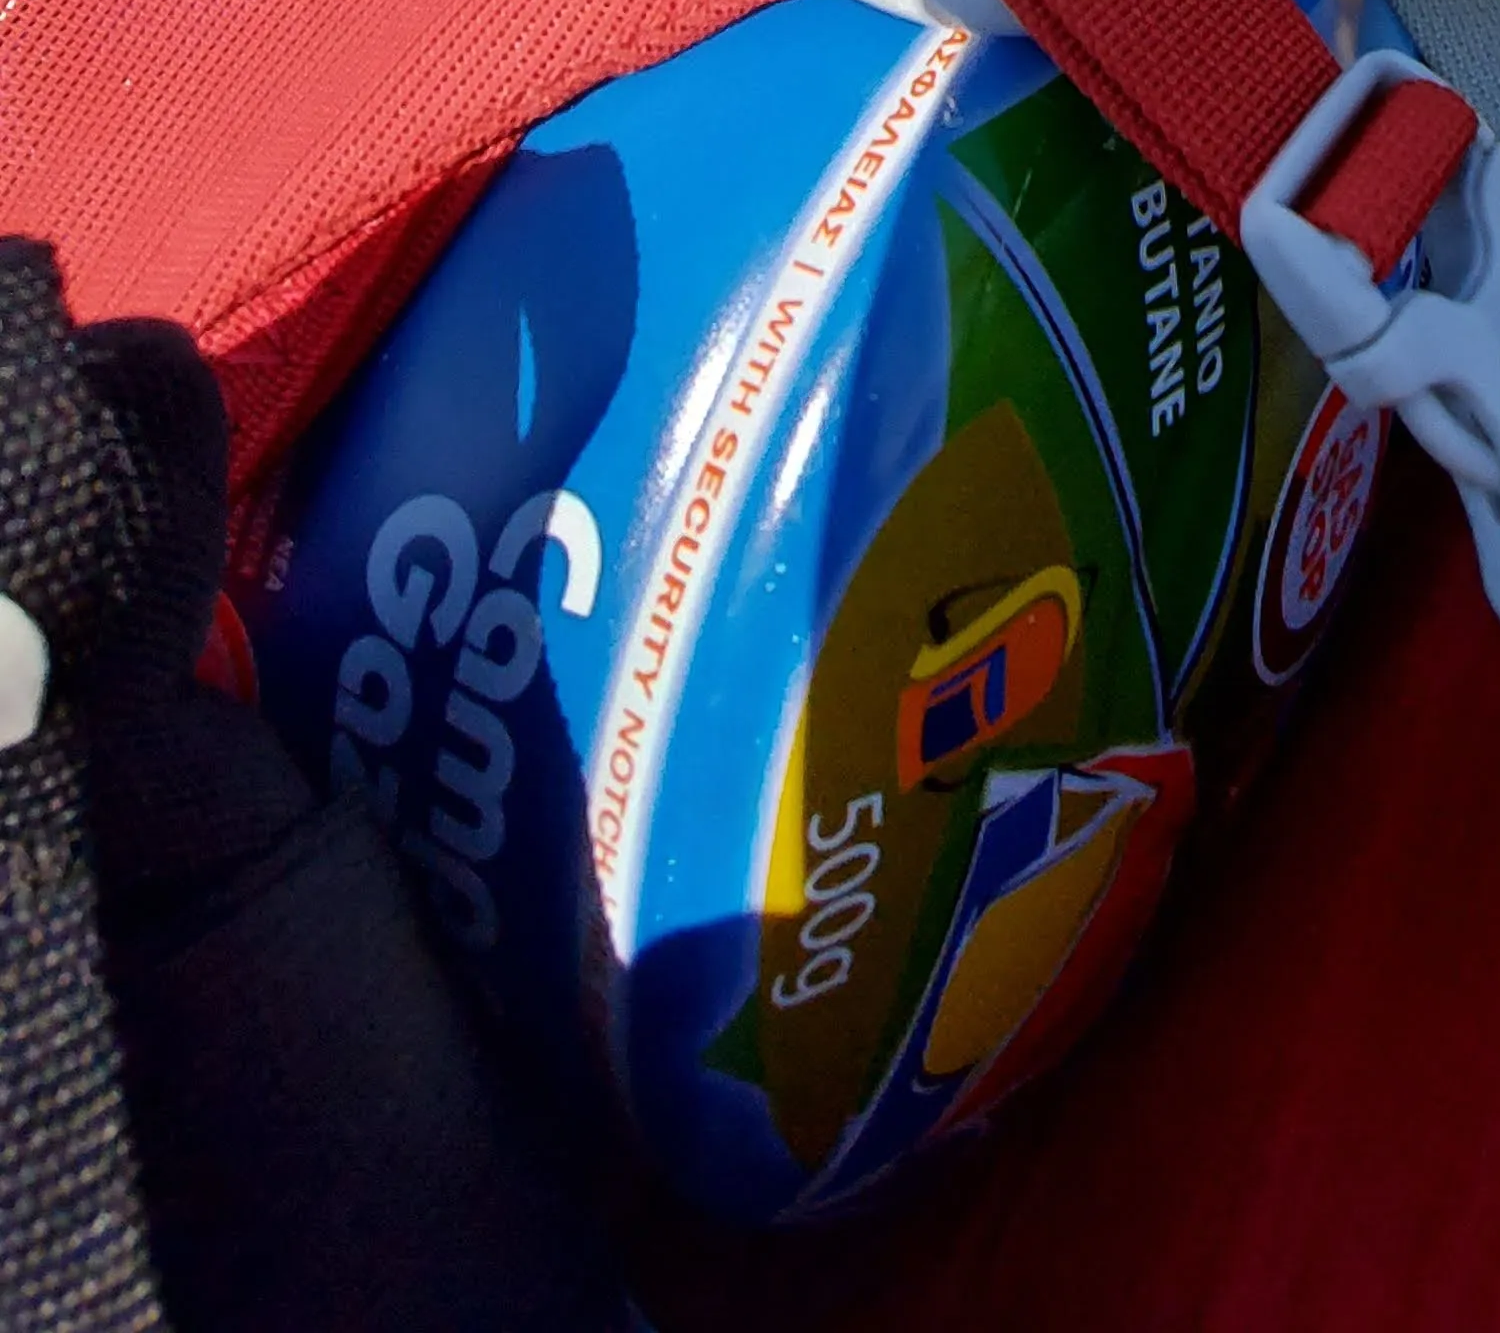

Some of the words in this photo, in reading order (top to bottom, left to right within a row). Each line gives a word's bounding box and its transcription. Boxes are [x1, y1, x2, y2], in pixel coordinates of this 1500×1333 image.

[731, 299, 803, 415] WITH
[1130, 179, 1186, 438] BUTANE
[633, 427, 738, 701] SECURITY
[593, 708, 645, 876] NOTCH
[771, 792, 884, 1009] 500g
